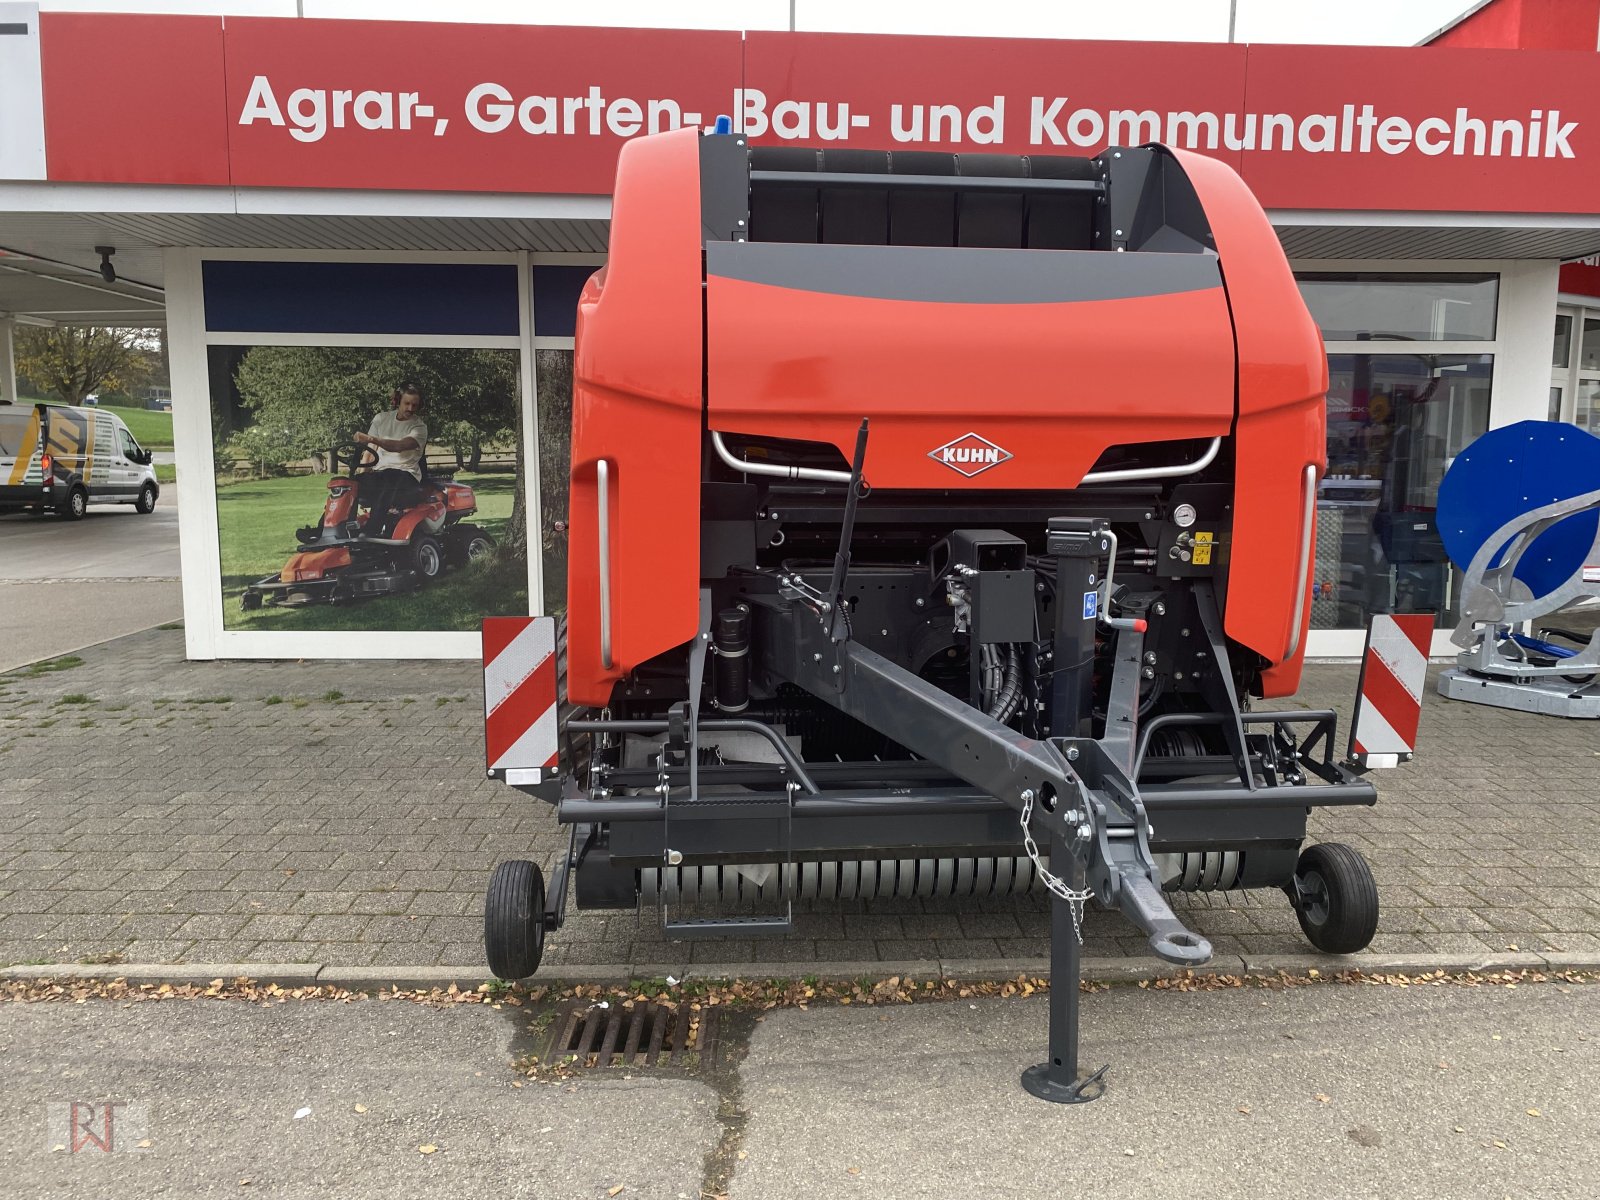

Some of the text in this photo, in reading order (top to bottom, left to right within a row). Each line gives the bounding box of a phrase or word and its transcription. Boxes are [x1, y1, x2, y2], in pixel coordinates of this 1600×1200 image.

[238, 75, 448, 142] Agrar-,
[732, 88, 870, 141] Bau-
[890, 95, 1005, 144] und
[1029, 96, 1579, 159] Kommunaltechnik
[943, 447, 999, 463] KUHN
